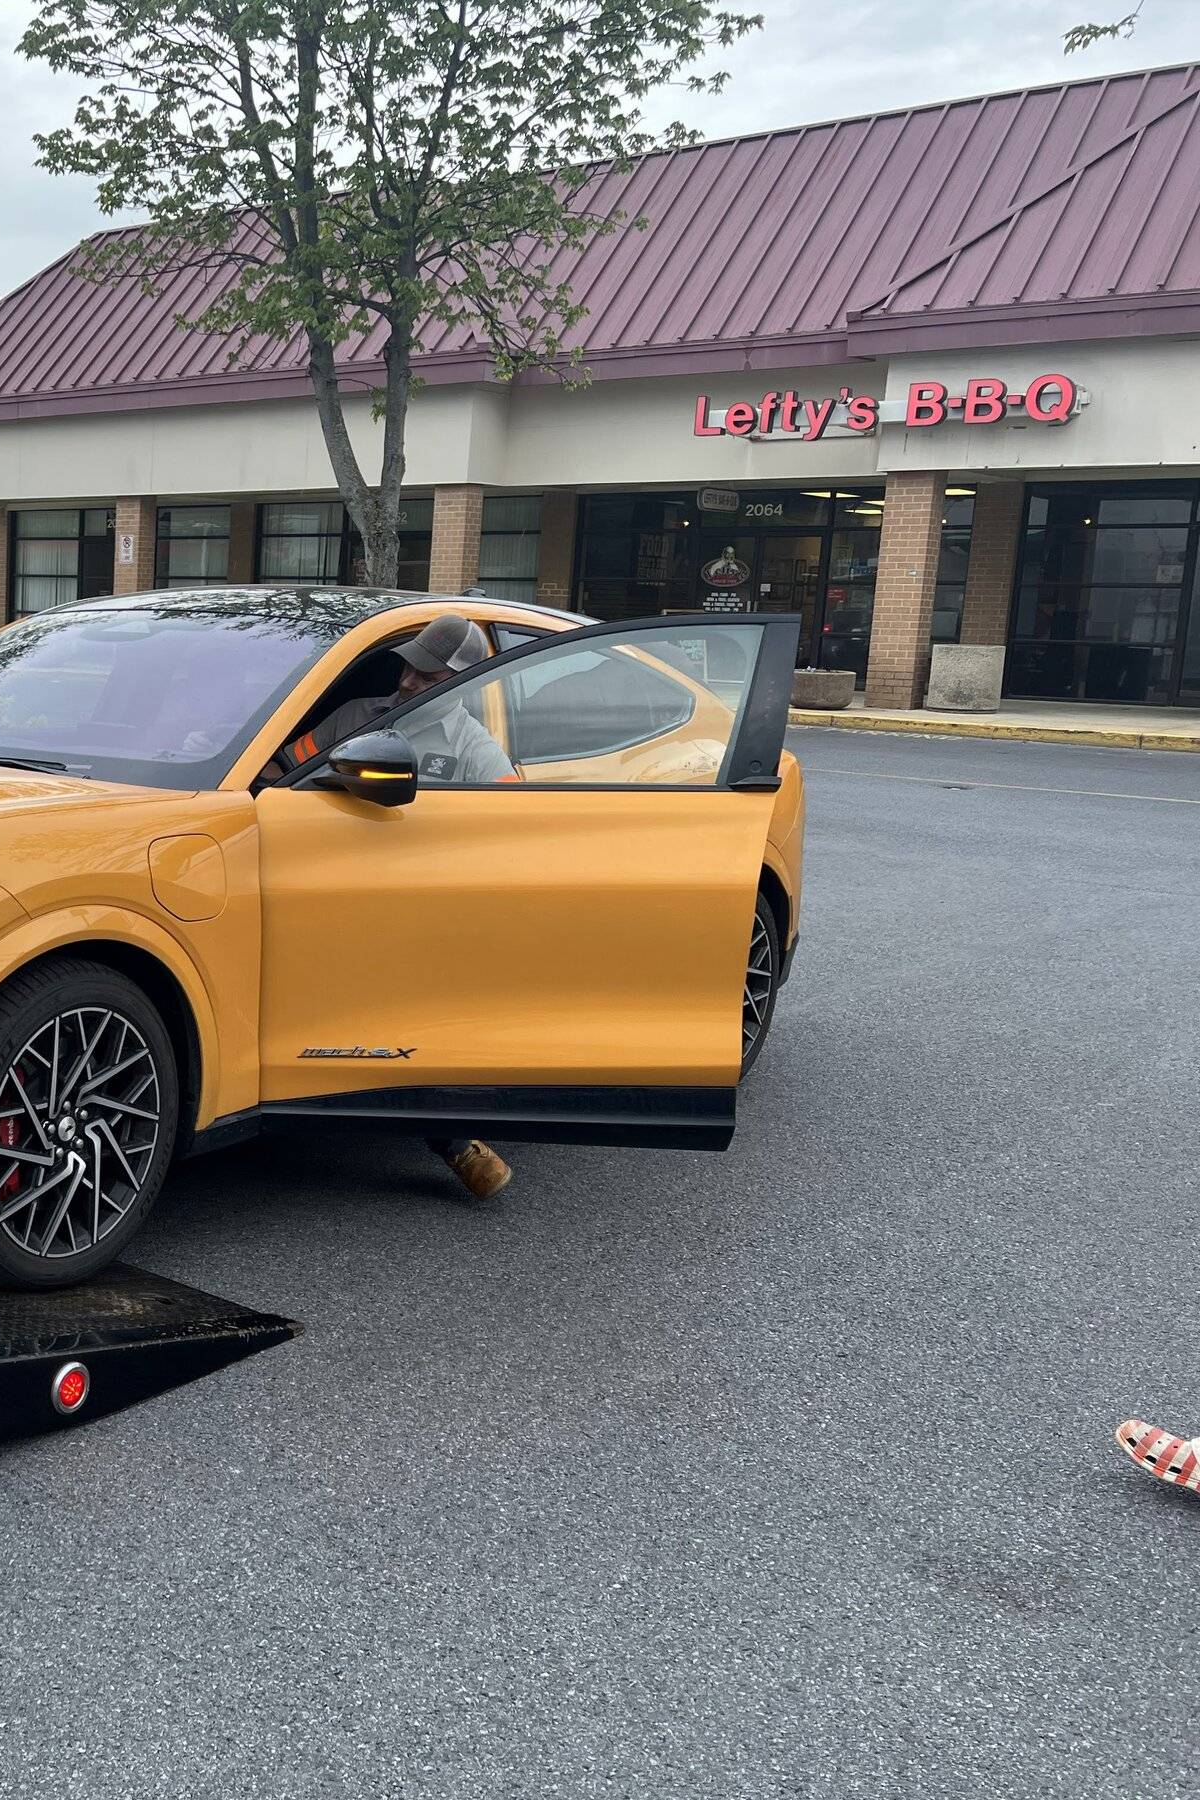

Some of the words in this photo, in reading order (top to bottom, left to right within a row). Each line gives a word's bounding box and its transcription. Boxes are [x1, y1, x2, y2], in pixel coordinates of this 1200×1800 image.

[694, 386, 880, 441] Lefty's
[905, 373, 1077, 427] B-B-Q
[745, 503, 784, 517] 2064
